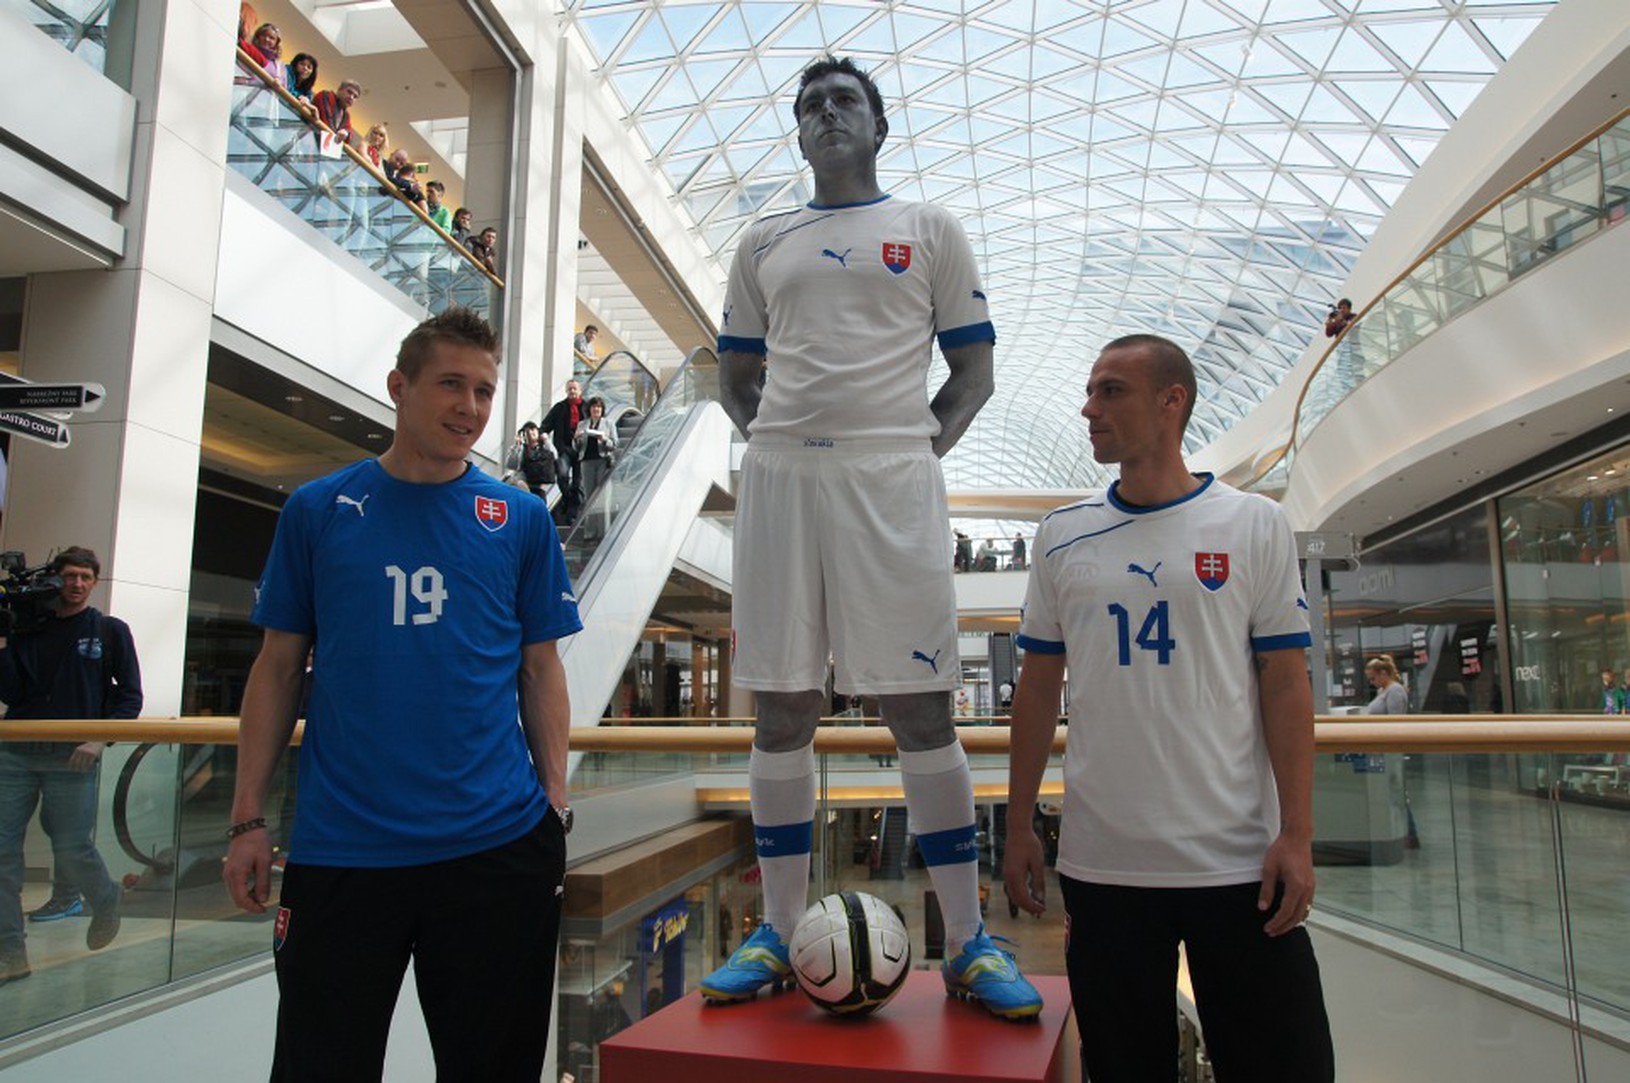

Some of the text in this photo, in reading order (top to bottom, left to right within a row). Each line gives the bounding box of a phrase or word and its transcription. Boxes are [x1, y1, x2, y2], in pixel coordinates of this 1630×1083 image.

[31, 421, 56, 436] COURT
[385, 565, 448, 625] 19
[1107, 600, 1176, 666] 14
